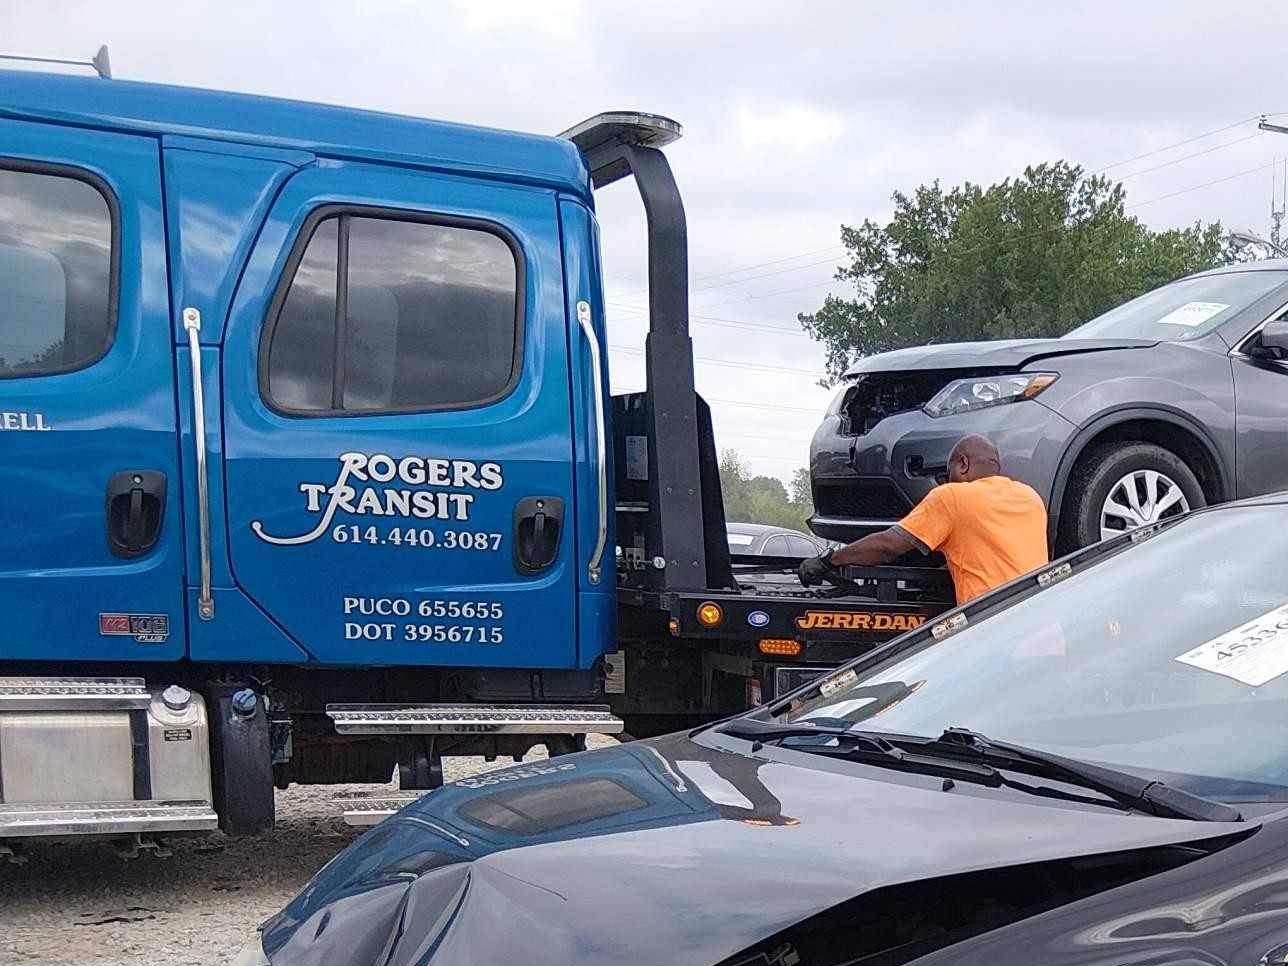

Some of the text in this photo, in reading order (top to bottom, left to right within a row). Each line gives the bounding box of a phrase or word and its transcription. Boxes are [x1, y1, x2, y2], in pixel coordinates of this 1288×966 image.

[0, 412, 51, 431] ELL
[340, 452, 503, 490] ROGERS
[300, 483, 474, 521] TRANSIT
[333, 524, 503, 551] 614.440.3087
[343, 597, 503, 619] PUCO 655655
[344, 622, 503, 643] DOT 3956715
